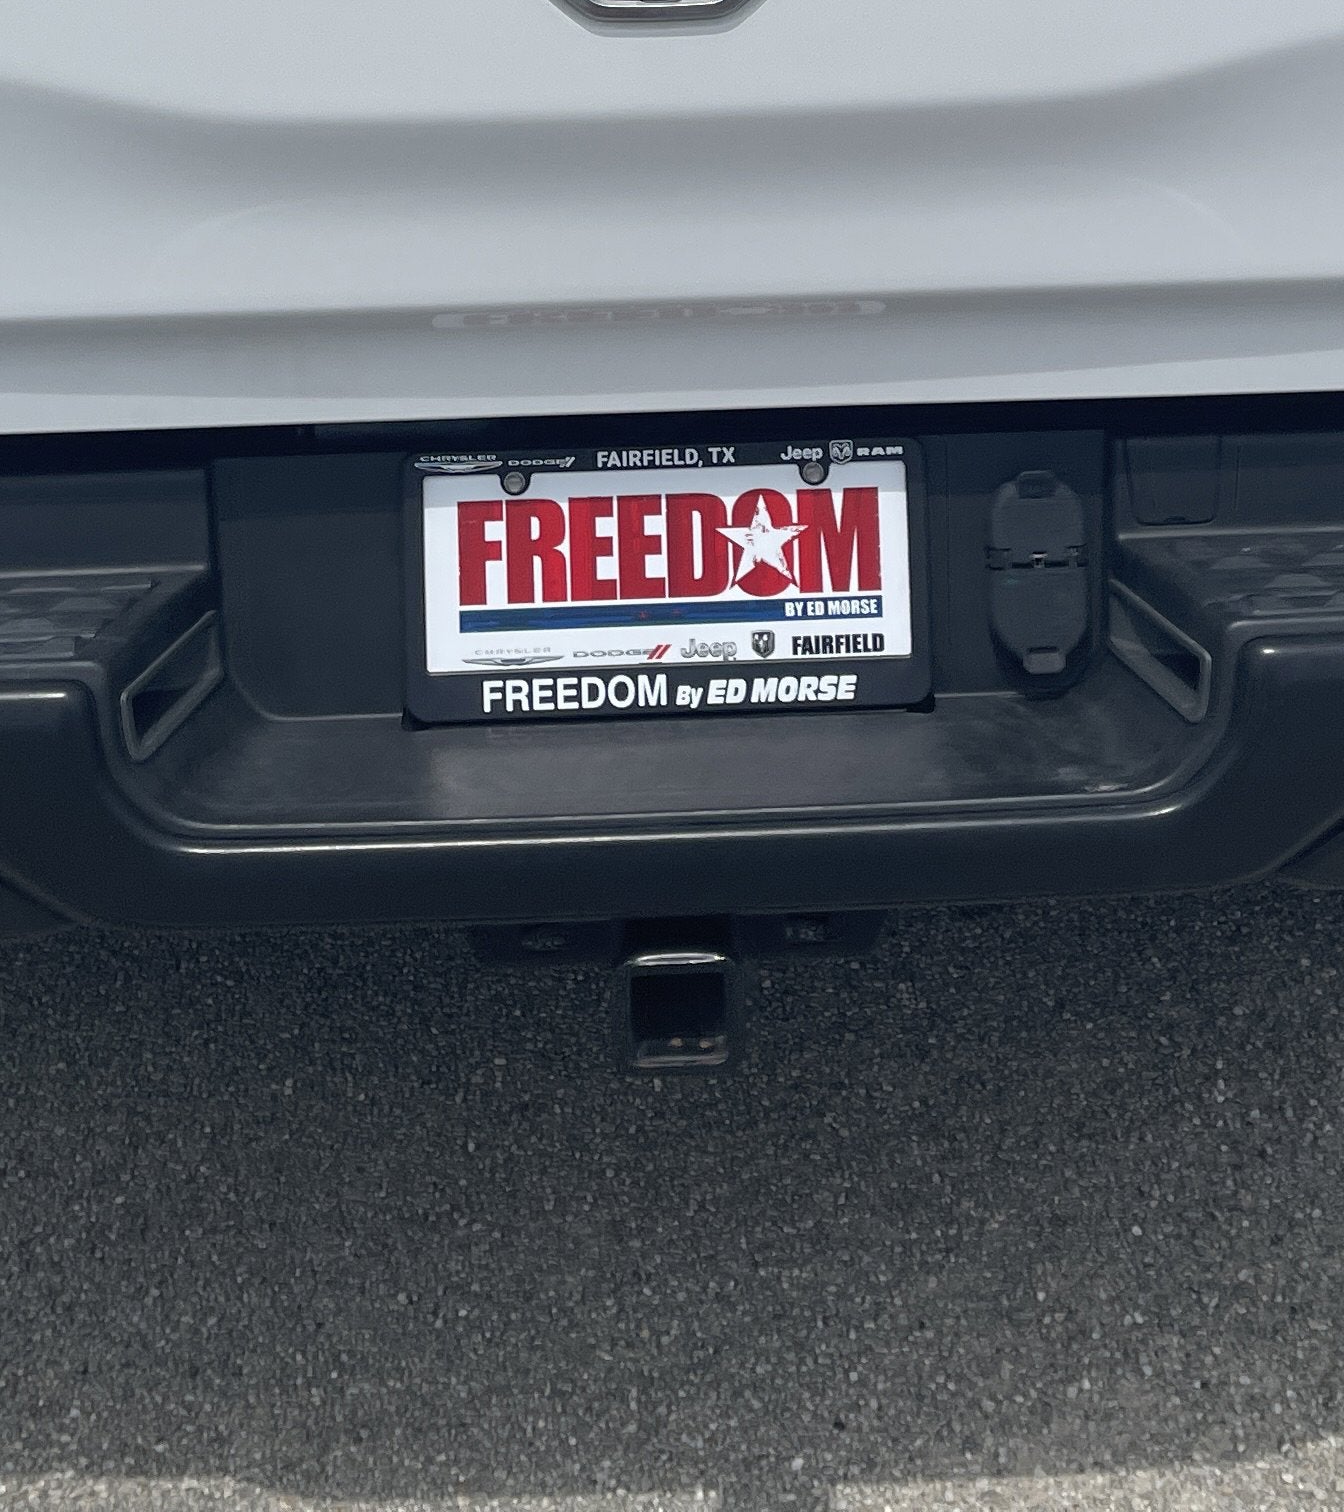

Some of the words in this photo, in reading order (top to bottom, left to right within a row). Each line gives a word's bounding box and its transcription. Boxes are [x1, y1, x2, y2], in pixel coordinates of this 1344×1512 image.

[419, 454, 497, 462] CHRYSLER
[596, 448, 703, 468] FAIRFIELD,
[708, 446, 735, 464] TX
[780, 445, 823, 461] Jeep
[856, 445, 904, 457] RAM
[457, 486, 882, 606] FREEDOM
[784, 601, 804, 617] BY
[806, 600, 825, 616] ED
[827, 598, 878, 616] MORSE
[572, 648, 654, 658] DODGE
[680, 638, 737, 661] Jeep
[791, 632, 885, 656] FAIRFIELD
[482, 674, 667, 713] FREEDOM
[707, 678, 748, 704] ED
[750, 674, 857, 703] MORSE
